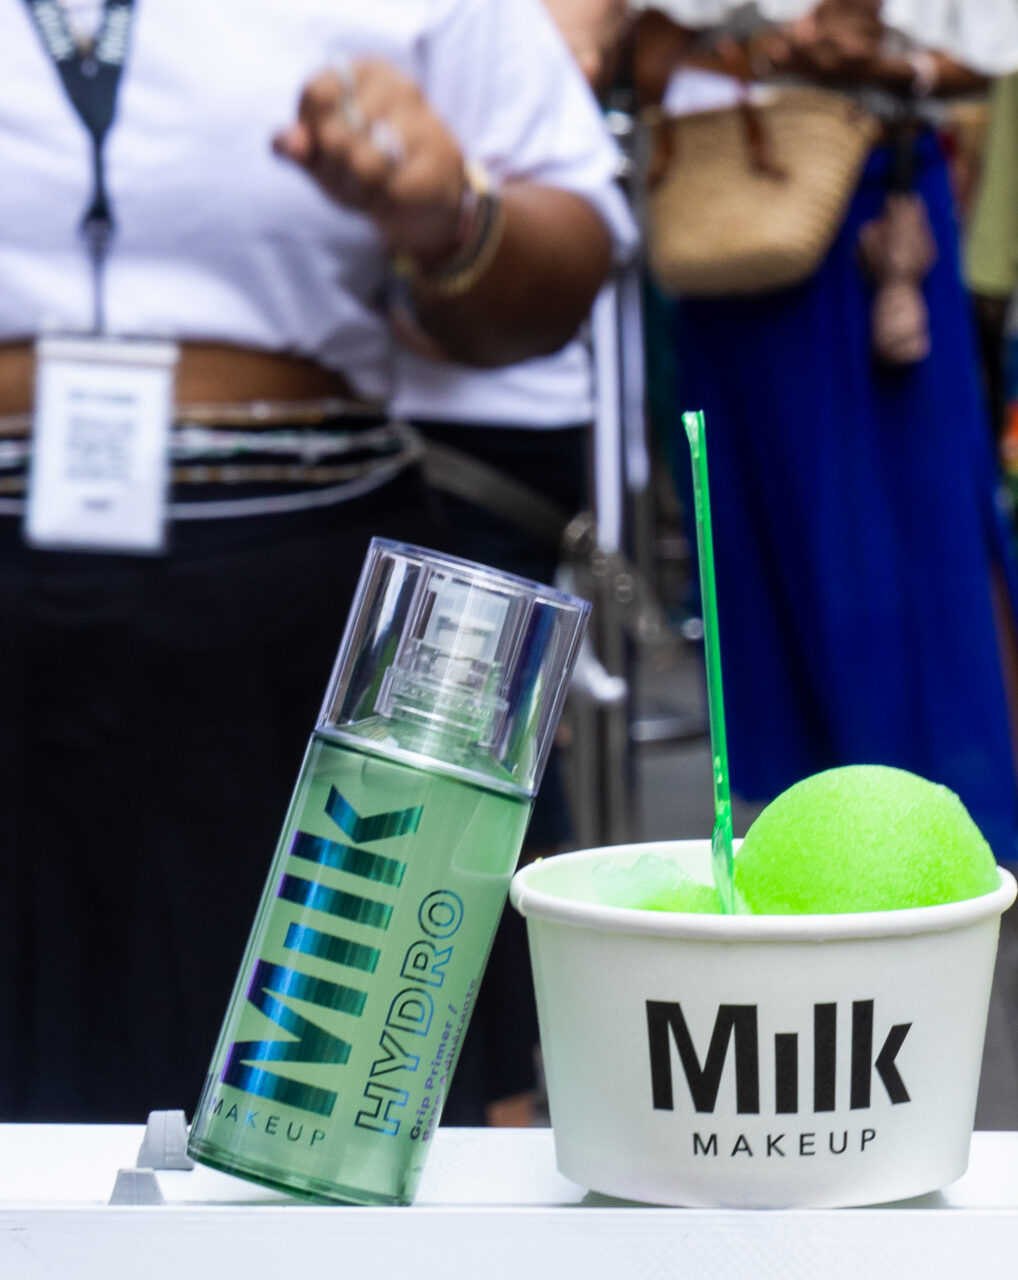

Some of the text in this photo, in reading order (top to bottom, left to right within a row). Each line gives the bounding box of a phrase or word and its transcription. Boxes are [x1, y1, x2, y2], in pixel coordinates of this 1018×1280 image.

[355, 889, 465, 1136] HYDRO
[645, 998, 913, 1115] Milk
[210, 1096, 326, 1147] MAKEUP
[409, 1098, 431, 1141] Grip
[425, 1020, 453, 1090] Primer
[693, 1129, 877, 1157] MAKEUP
